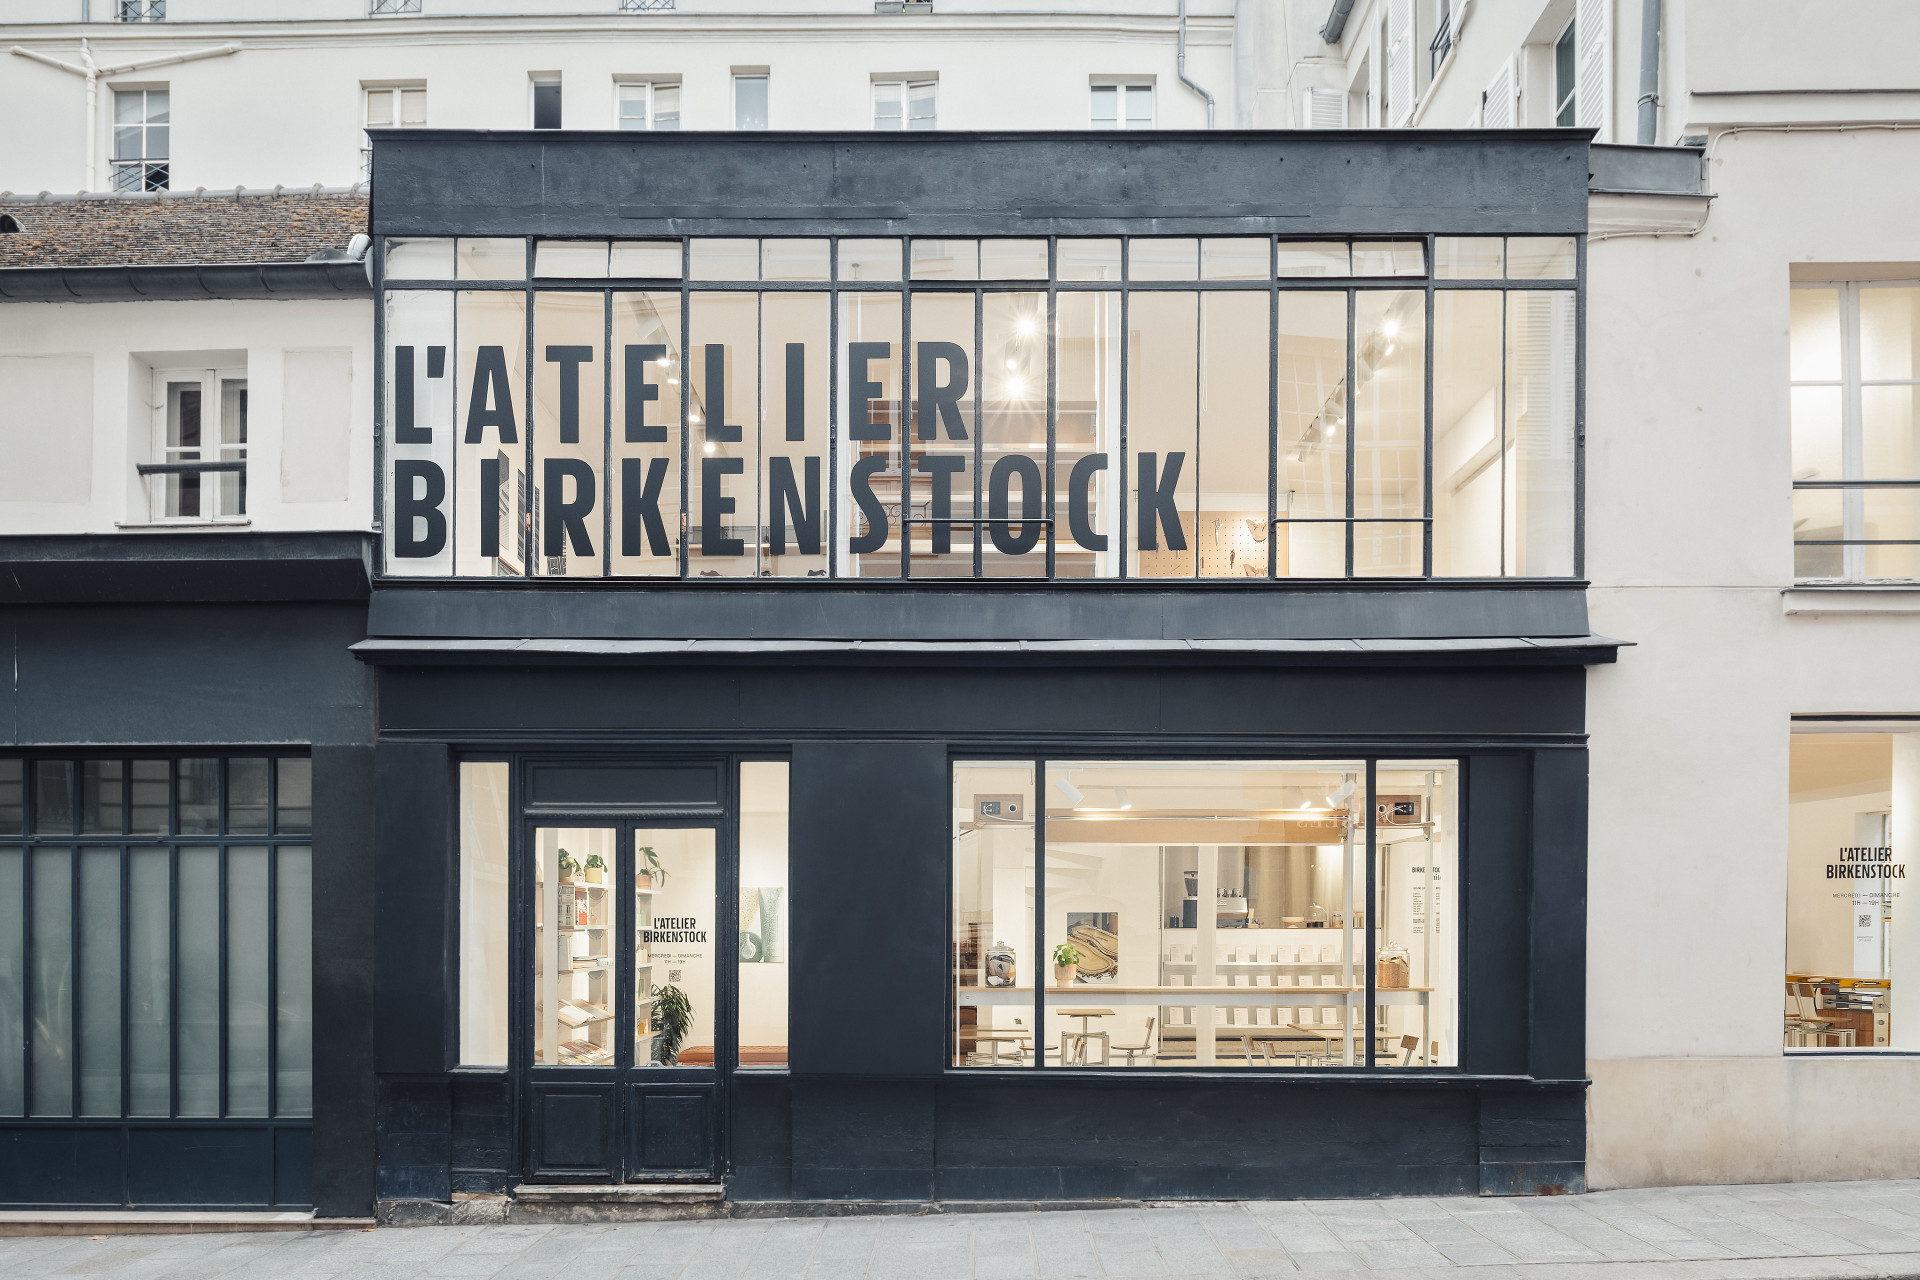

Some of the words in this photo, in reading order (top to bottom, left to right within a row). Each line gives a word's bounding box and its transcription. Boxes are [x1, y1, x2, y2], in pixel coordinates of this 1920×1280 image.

[395, 342, 969, 444] L'ATELIER
[395, 452, 1188, 559] BIRKENSTOCK
[1839, 847, 1892, 862] L'ATELIER
[1826, 863, 1906, 879] BIRKENSTOCK
[653, 917, 696, 929] L'ATELIER
[643, 931, 707, 943] BIRKENSTOCK
